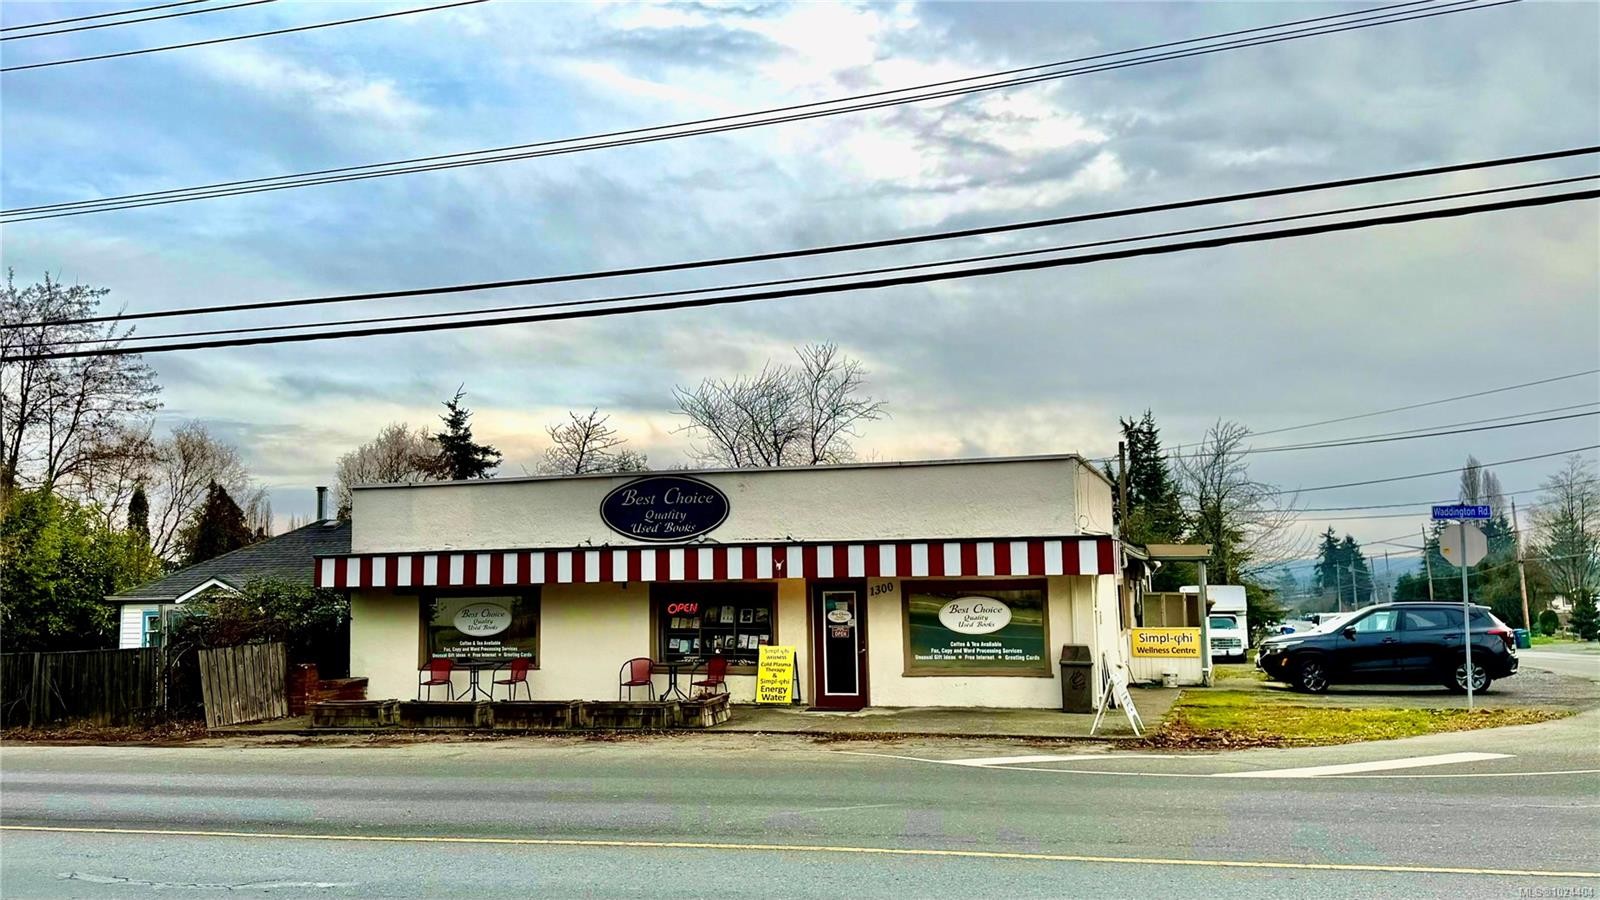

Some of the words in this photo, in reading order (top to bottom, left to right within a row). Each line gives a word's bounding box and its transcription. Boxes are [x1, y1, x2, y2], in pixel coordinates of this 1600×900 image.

[621, 488, 656, 506] Best
[664, 487, 714, 505] Choice
[644, 510, 687, 523] Quality
[1433, 507, 1476, 517] Waddington
[631, 522, 661, 534] Used
[664, 521, 697, 533] Books
[870, 582, 894, 597] 1300
[461, 609, 478, 618] Best
[481, 608, 505, 618] Choice
[667, 603, 699, 614] OPEN
[948, 604, 969, 614] Best
[973, 603, 1003, 614] Choice
[760, 685, 788, 695] Energy
